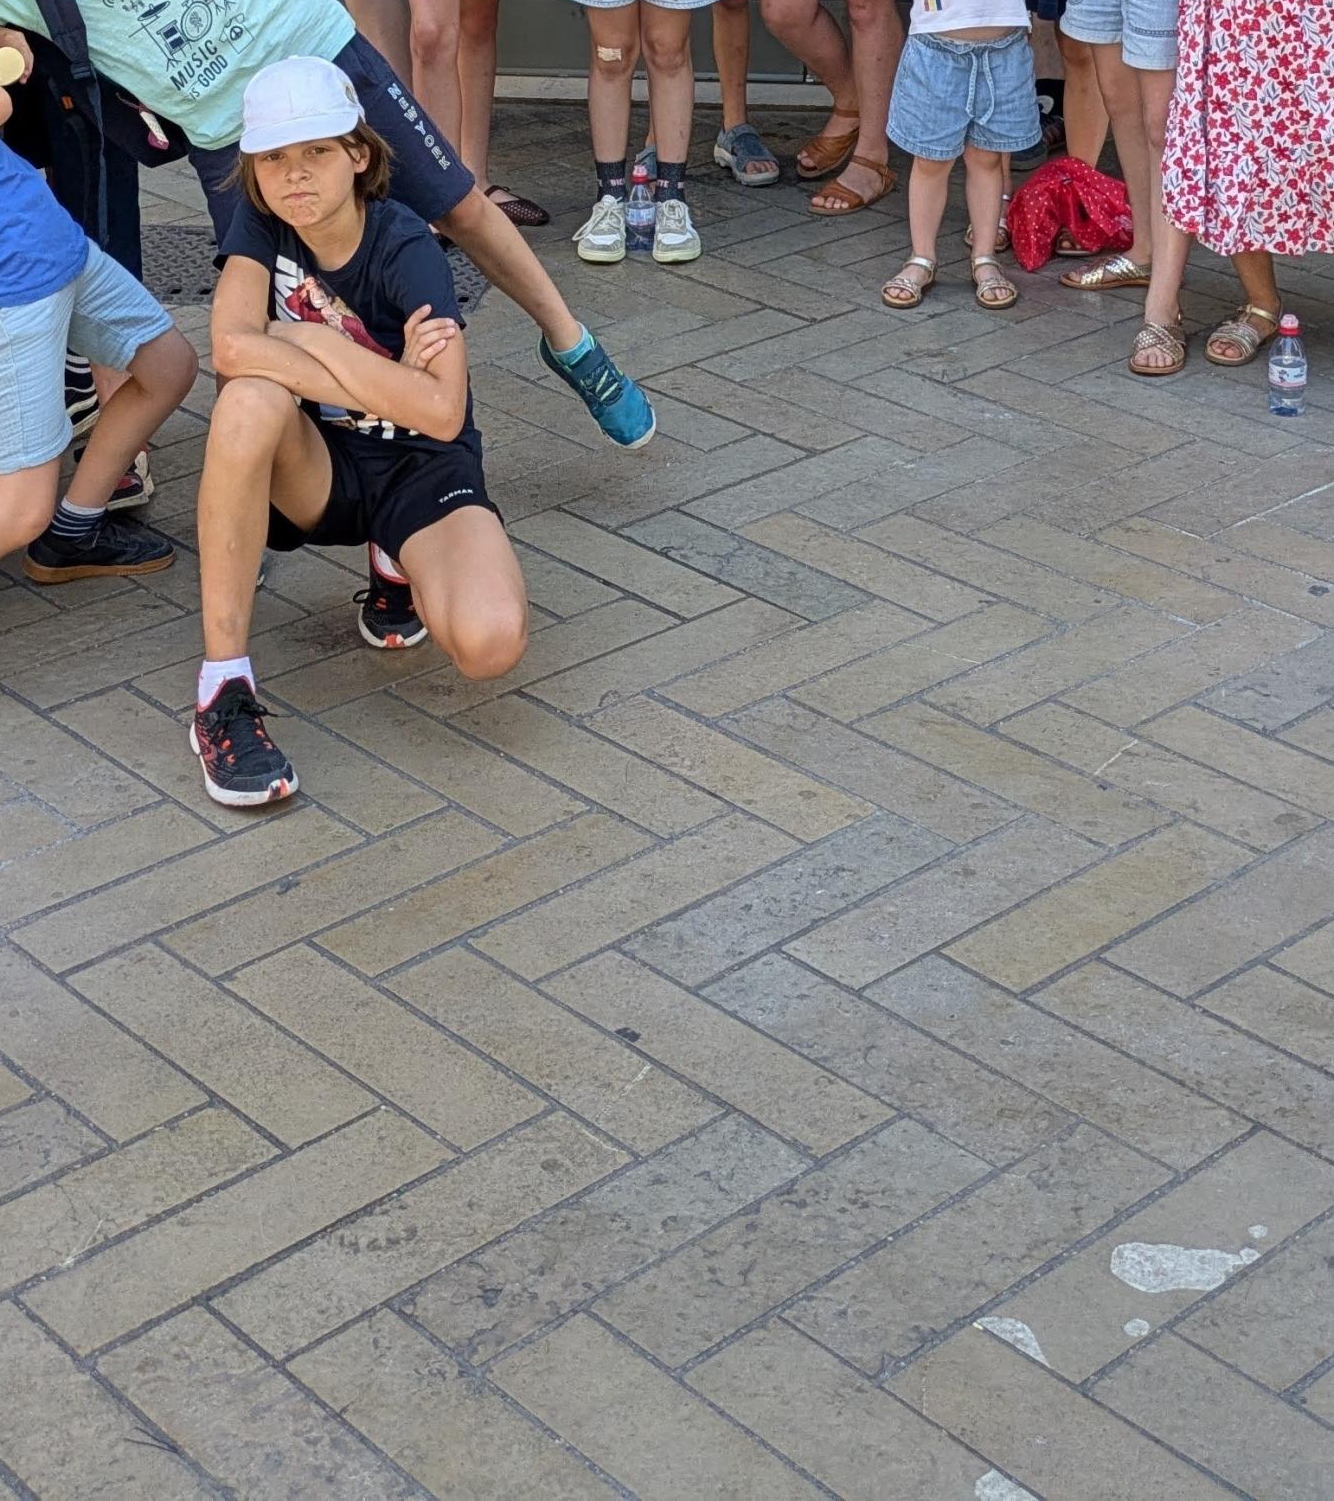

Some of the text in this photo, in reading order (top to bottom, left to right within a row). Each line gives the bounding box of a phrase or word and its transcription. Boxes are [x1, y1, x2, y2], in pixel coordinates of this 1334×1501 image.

[169, 39, 220, 92] MUSIC
[197, 54, 229, 89] GOOD
[414, 120, 451, 171] YORK
